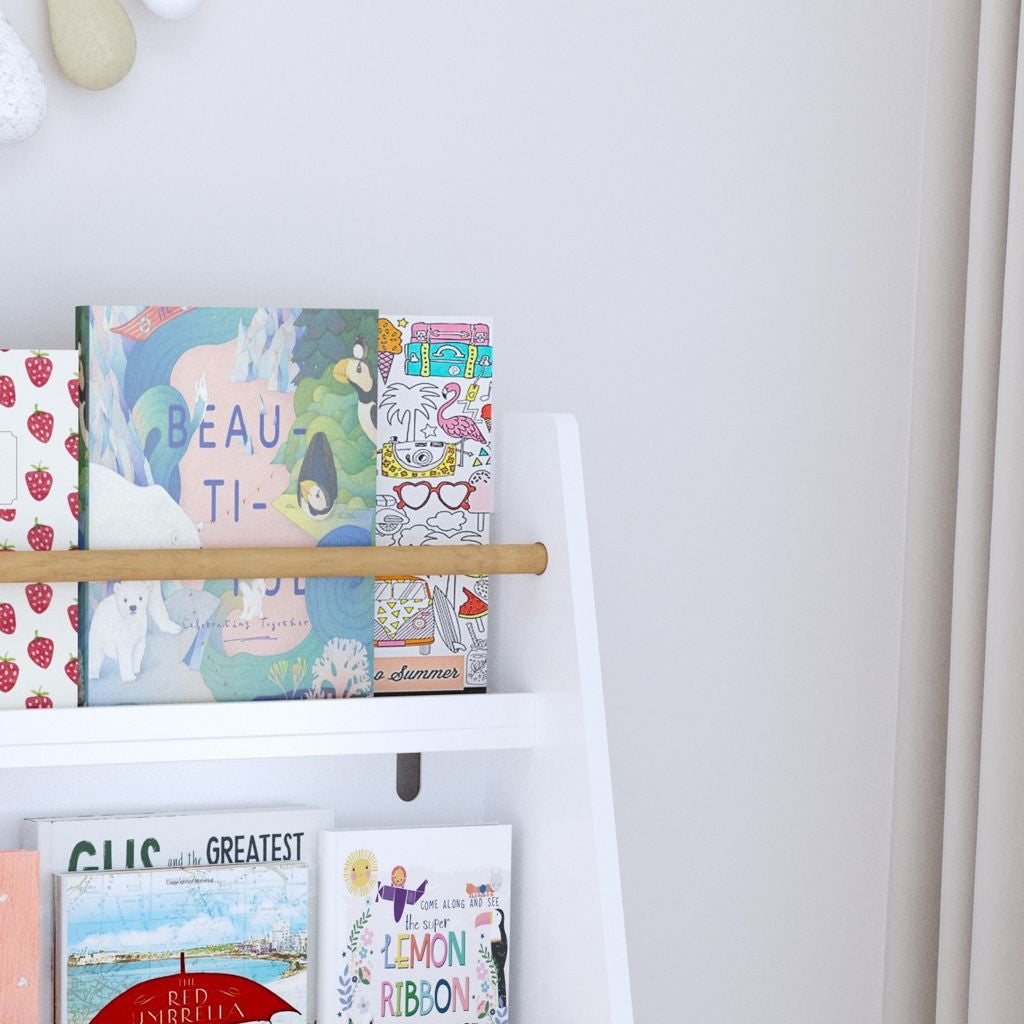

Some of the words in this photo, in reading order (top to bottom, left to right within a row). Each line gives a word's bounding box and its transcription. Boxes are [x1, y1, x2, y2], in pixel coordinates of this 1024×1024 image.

[203, 479, 267, 523] TI-
[182, 617, 251, 631] Celebrating
[260, 617, 310, 632] Together
[388, 664, 460, 682] Summer
[167, 850, 184, 867] and
[188, 849, 203, 866] the
[206, 832, 305, 865] GREATEST
[420, 899, 439, 911] COME
[442, 898, 466, 910] ALONG
[469, 897, 483, 908] AND
[487, 896, 500, 907] SEE
[405, 914, 420, 931] the
[422, 918, 451, 933] super
[380, 930, 466, 969] LEMON
[168, 988, 208, 1006] RED
[380, 976, 470, 1018] RIBBON
